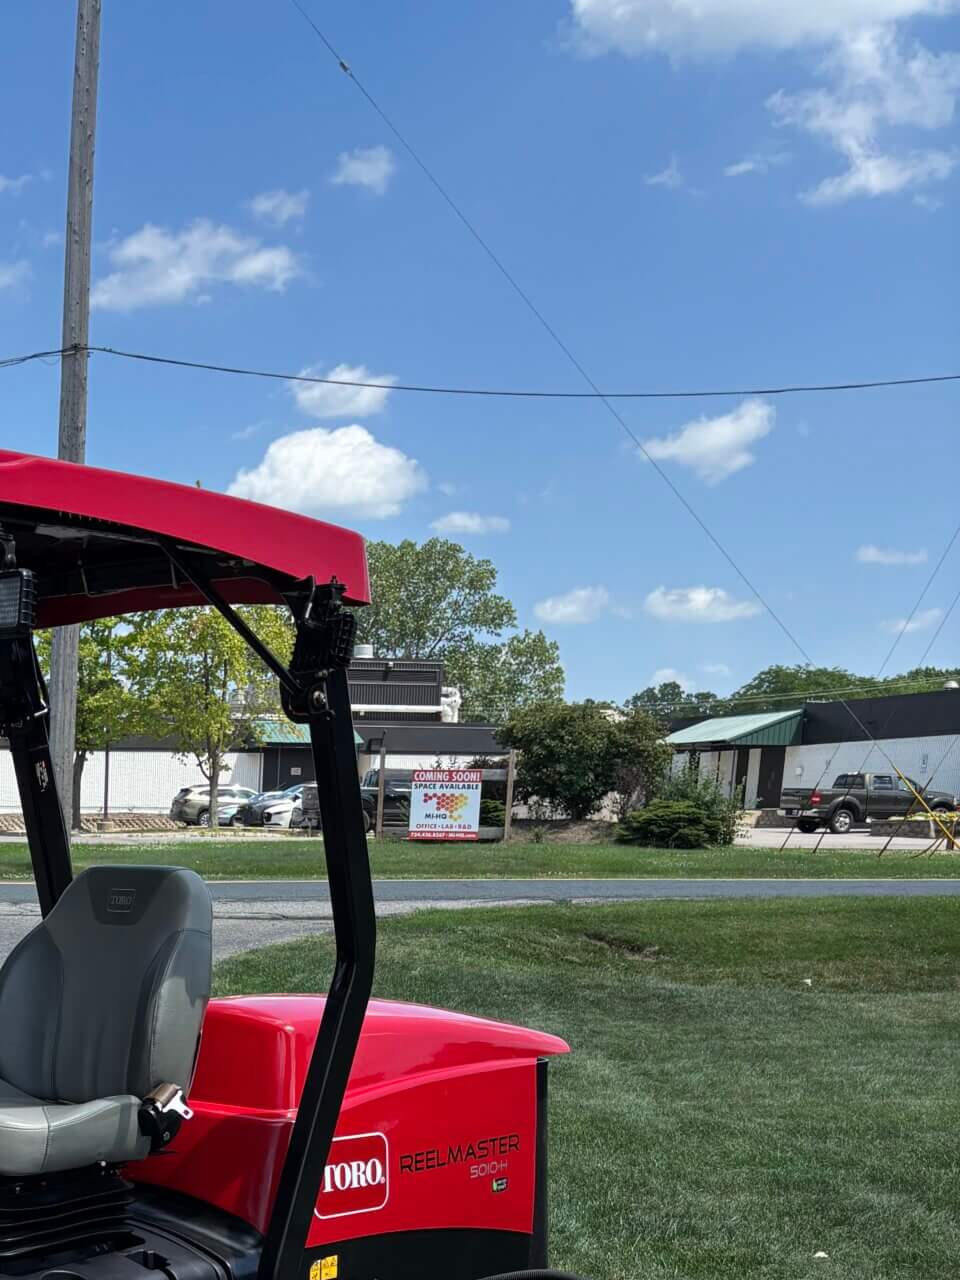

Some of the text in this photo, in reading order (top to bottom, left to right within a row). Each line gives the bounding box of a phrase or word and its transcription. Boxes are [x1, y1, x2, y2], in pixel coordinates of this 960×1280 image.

[414, 771, 480, 781] COMING SOON!
[424, 812, 447, 820] MI-HQ
[399, 1134, 521, 1174] REELMASTER
[323, 1158, 383, 1193] TORO
